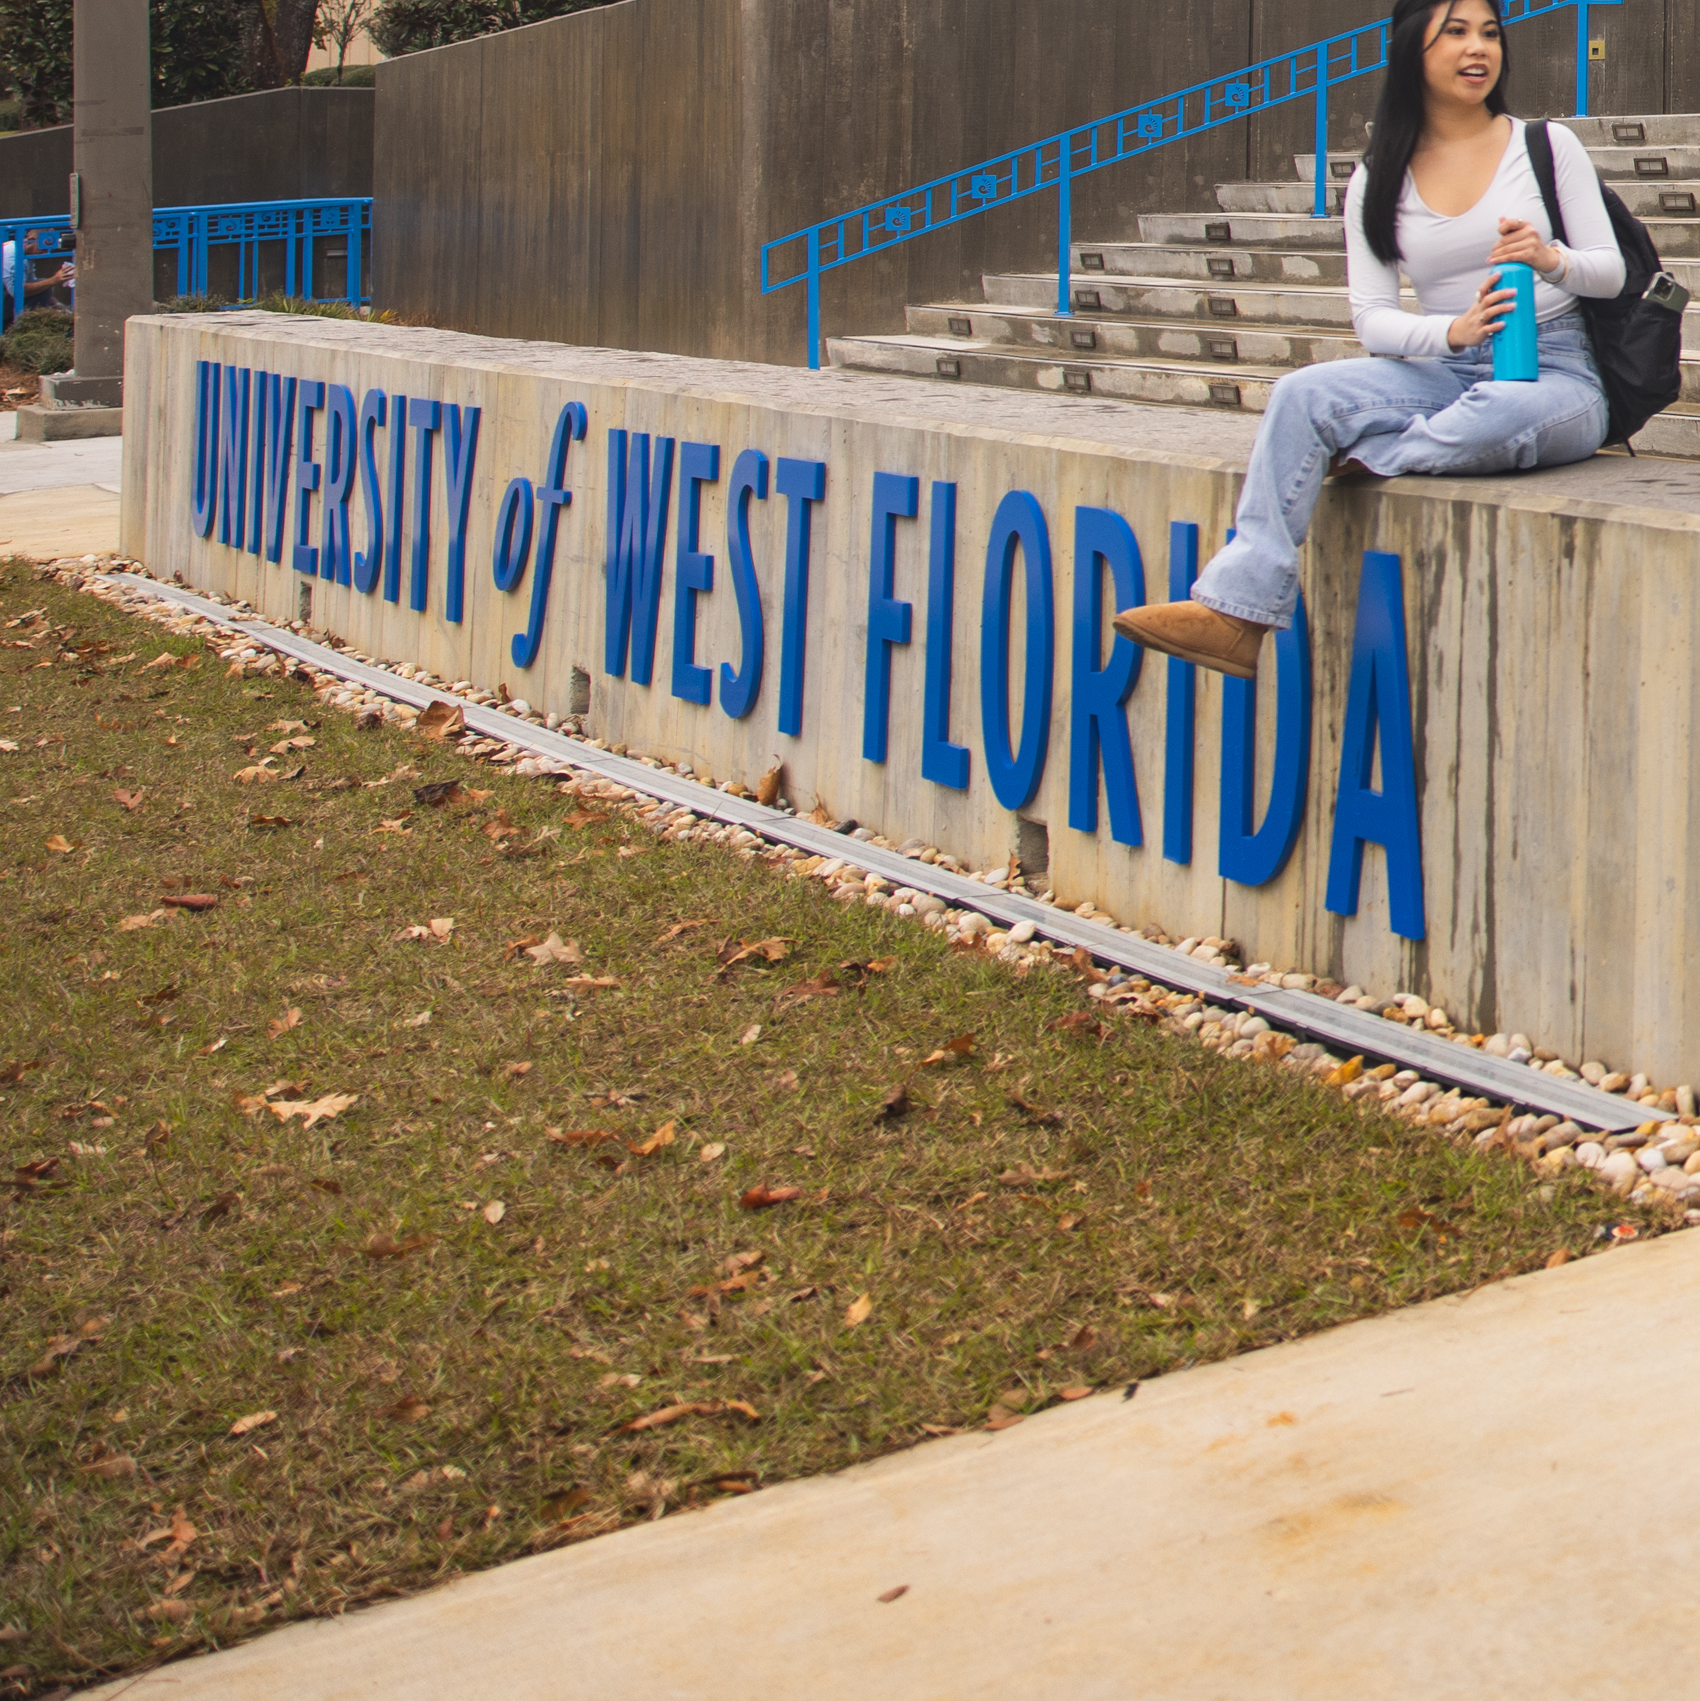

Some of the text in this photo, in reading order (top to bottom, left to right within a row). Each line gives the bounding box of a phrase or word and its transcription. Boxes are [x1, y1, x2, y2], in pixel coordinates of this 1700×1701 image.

[192, 360, 1426, 941] UNIVERSITY of WEST FLORIDA
